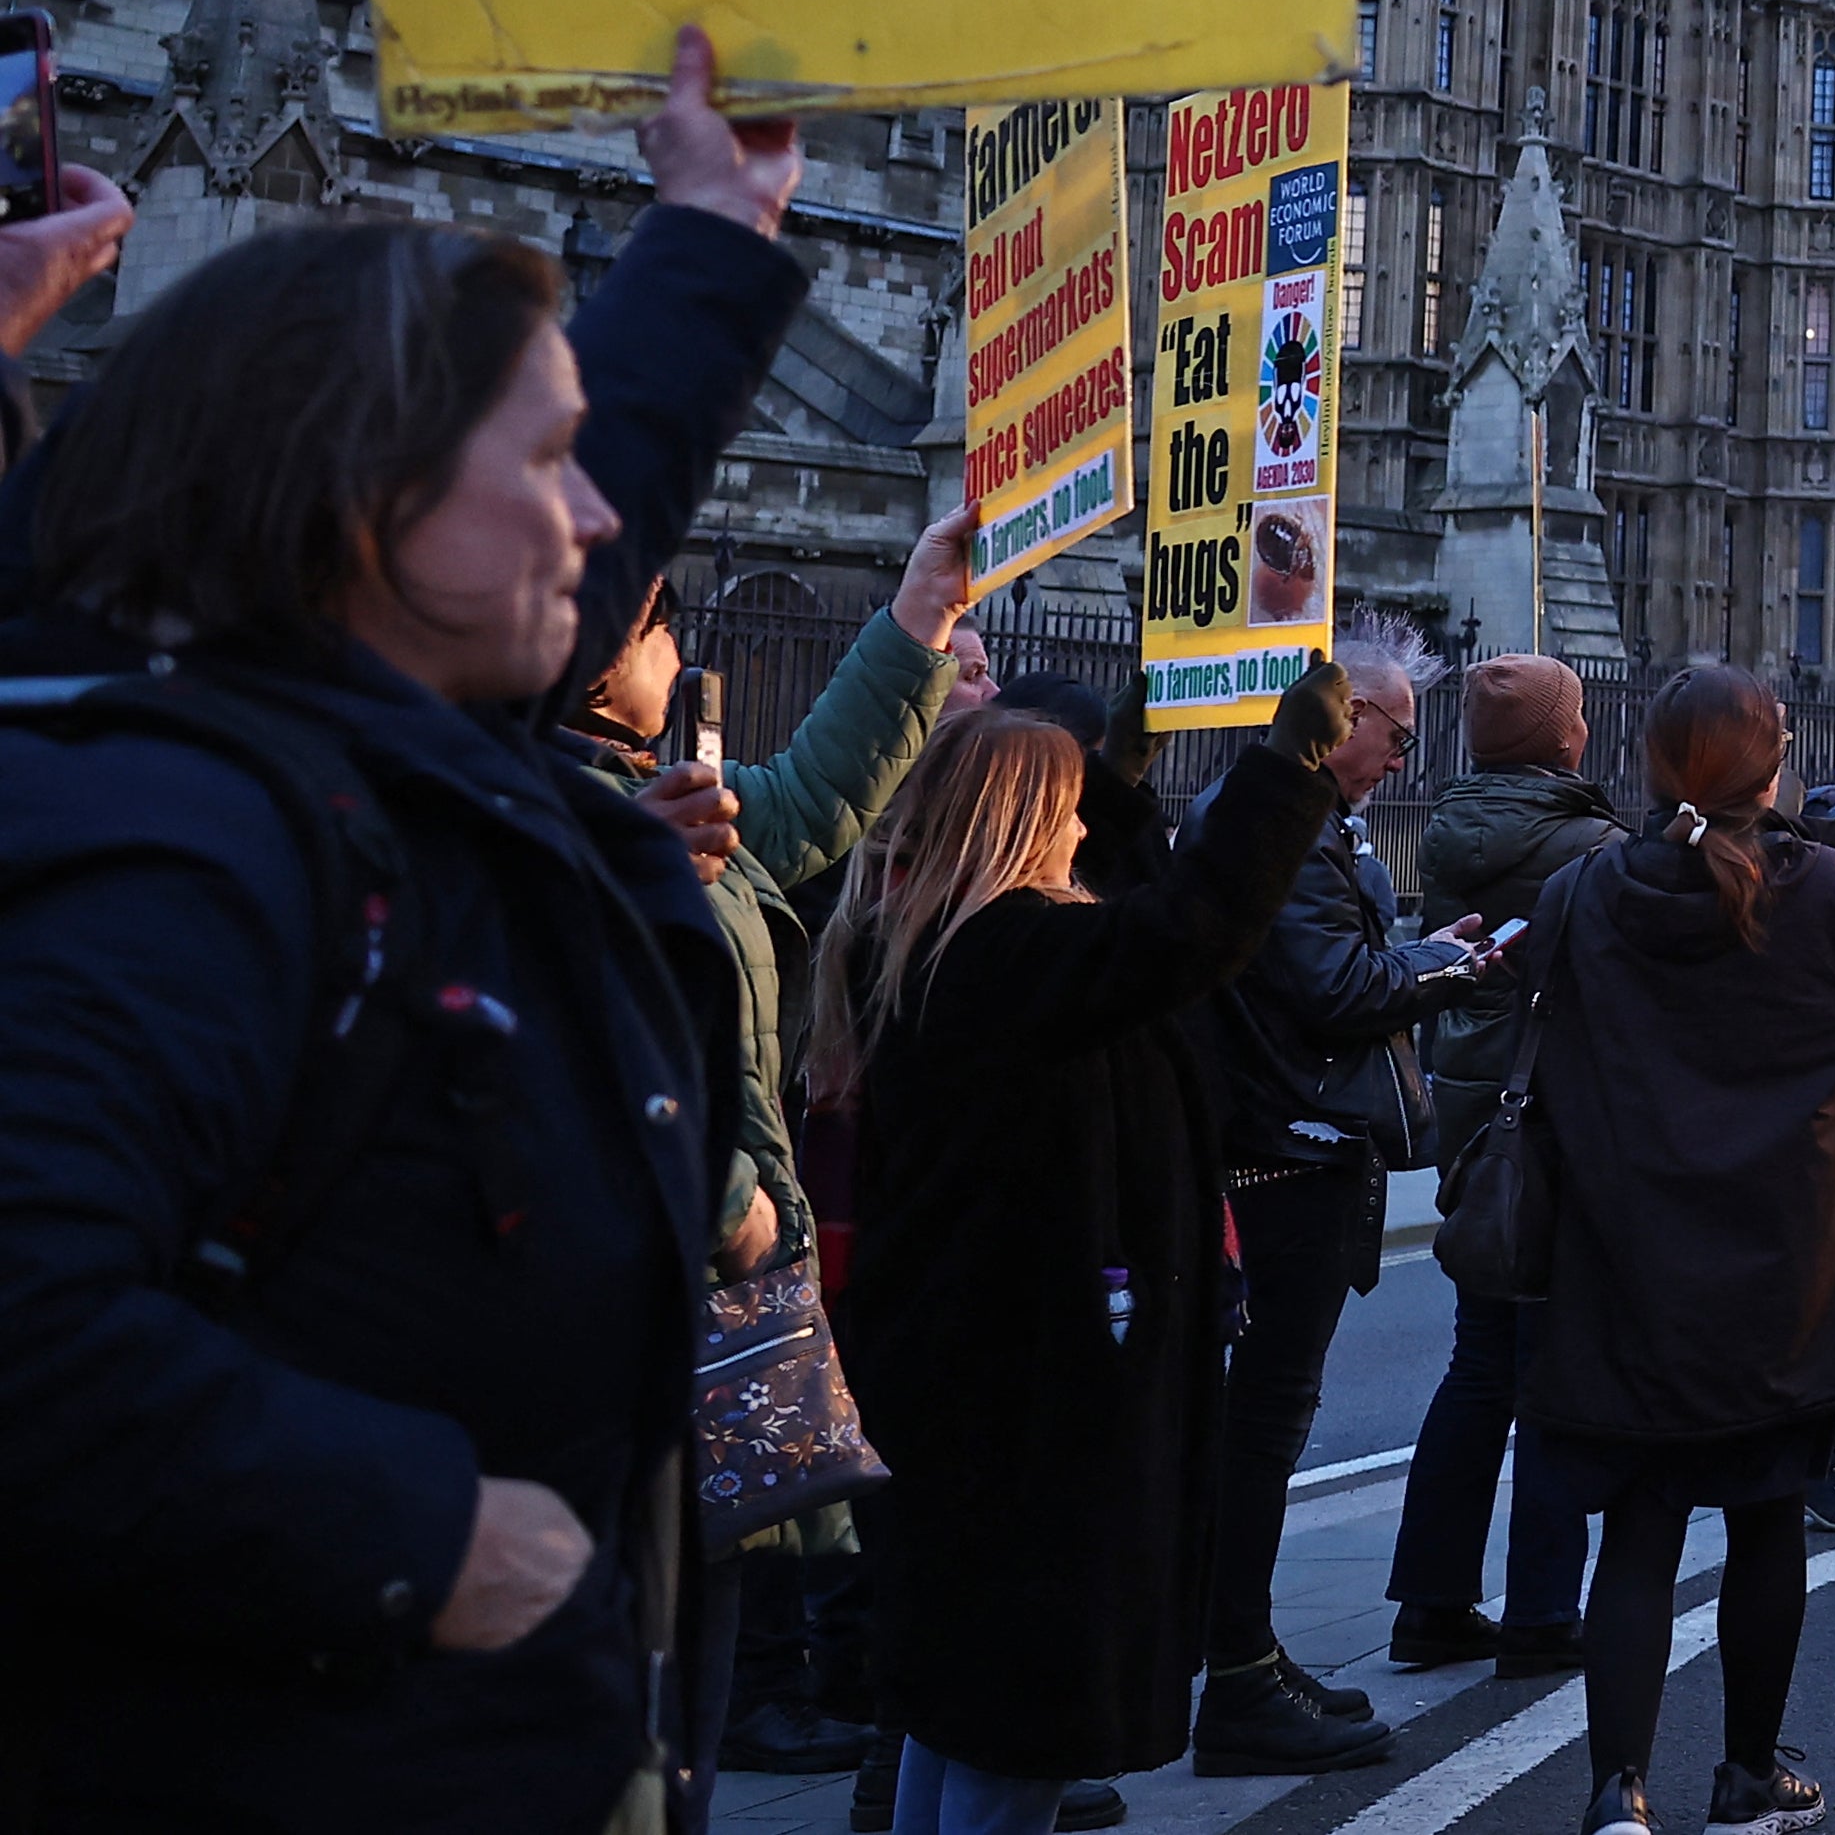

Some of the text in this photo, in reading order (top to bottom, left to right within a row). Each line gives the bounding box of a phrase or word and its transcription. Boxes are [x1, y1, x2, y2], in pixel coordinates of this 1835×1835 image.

[1168, 84, 1310, 198] NetZero
[1270, 191, 1336, 226] ECONOMIC
[1281, 172, 1325, 200] WORLD
[969, 206, 1043, 319] Call out
[1162, 199, 1264, 302] Scam
[1279, 219, 1323, 246] FORUM
[968, 231, 1119, 408] supermarkets'
[1273, 273, 1315, 310] Danger!
[964, 422, 1018, 511] price
[1169, 420, 1229, 512] the
[1256, 459, 1314, 490] AGENDA 2030
[970, 531, 987, 581] No
[1052, 485, 1071, 531] no
[1074, 453, 1113, 518] food.
[1146, 664, 1163, 703] No
[1166, 661, 1233, 701] farmers,
[1237, 657, 1258, 692] no
